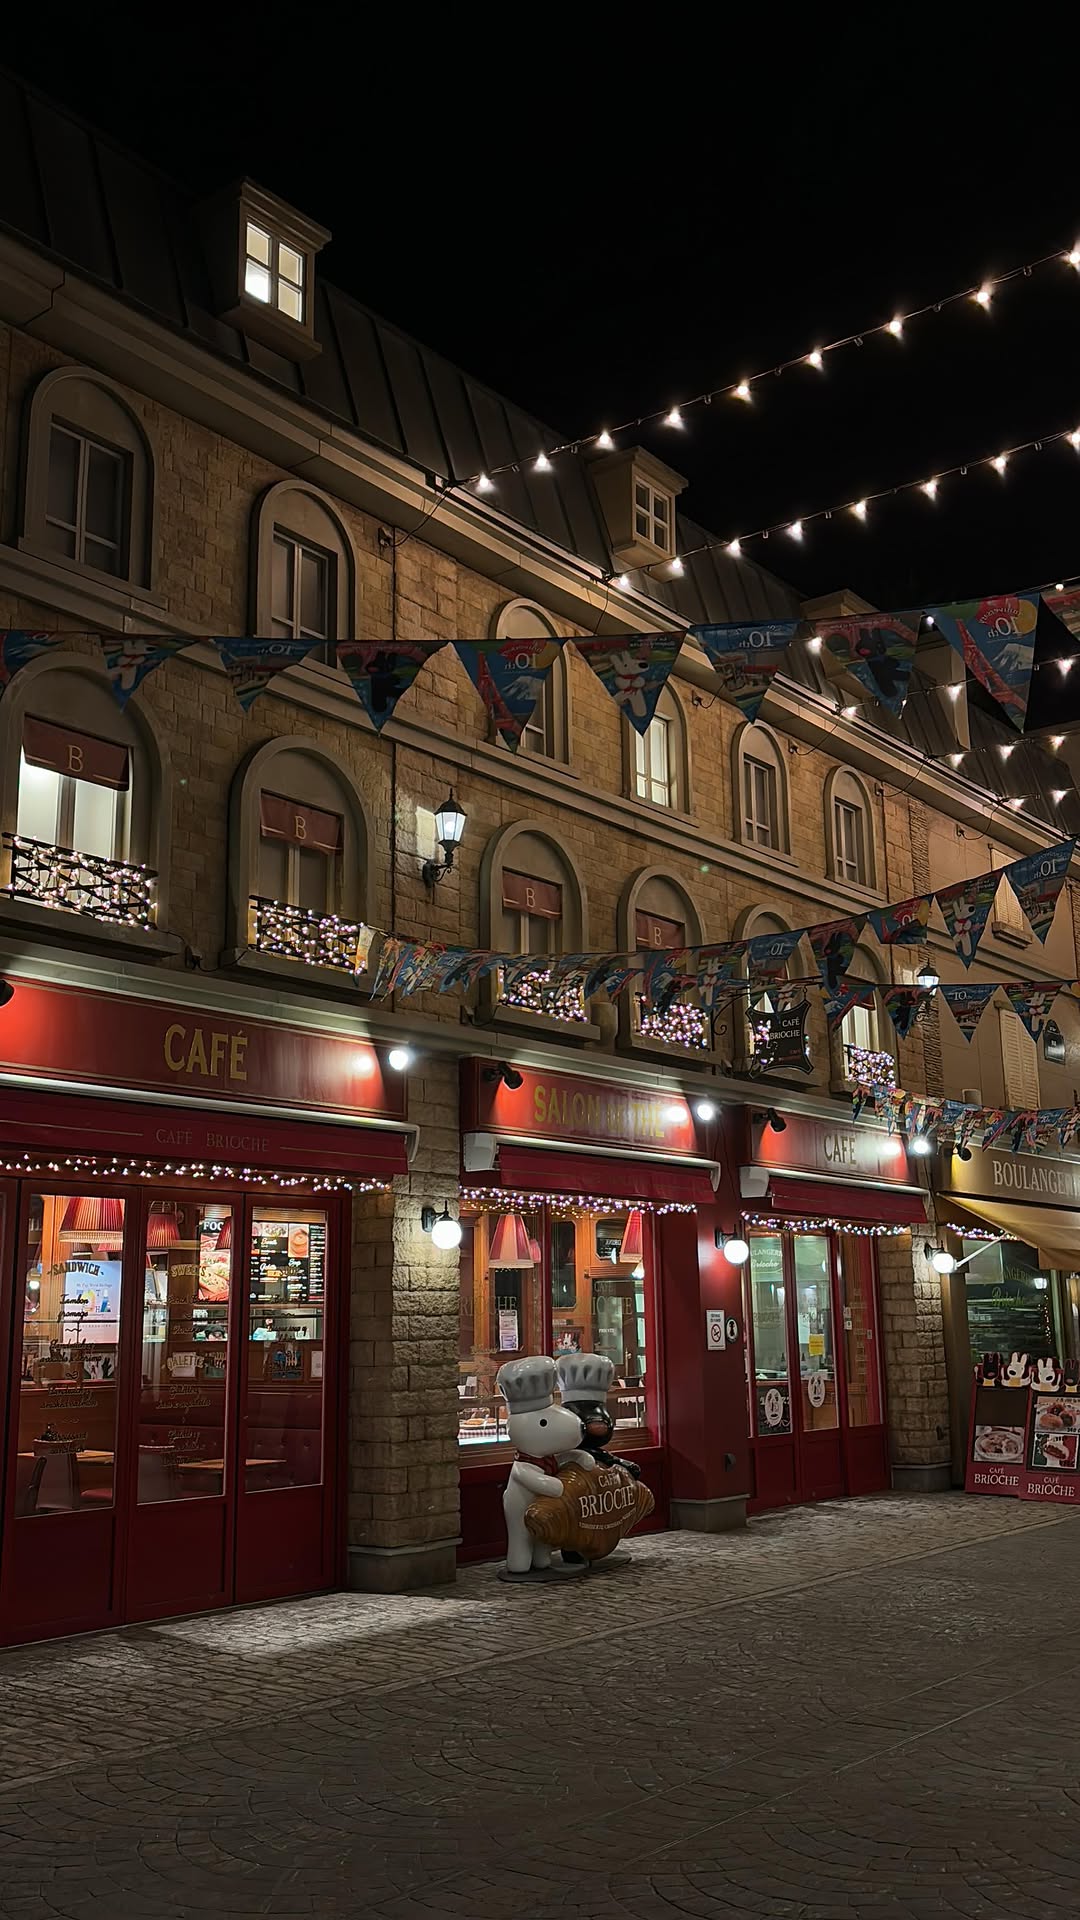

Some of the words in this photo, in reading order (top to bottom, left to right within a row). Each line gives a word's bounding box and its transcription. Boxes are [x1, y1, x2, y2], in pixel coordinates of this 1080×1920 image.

[67, 744, 84, 773] B
[293, 815, 307, 840] B
[525, 887, 536, 908] B
[653, 926, 662, 946] B
[782, 1017, 800, 1028] CAFÉ
[769, 1029, 801, 1040] BRIOCHE
[163, 1023, 249, 1081] CAFÉ
[533, 1085, 601, 1130] SALON
[155, 1127, 193, 1145] CAFÉ
[206, 1131, 270, 1153] BRIOCHE
[992, 1160, 1080, 1198] BOULANGERI
[53, 1261, 101, 1276] SANDWICH
[974, 1473, 1020, 1487] BRIOCHE
[1027, 1483, 1075, 1497] BRIOCHE
[578, 1485, 635, 1519] BRIOCHE
